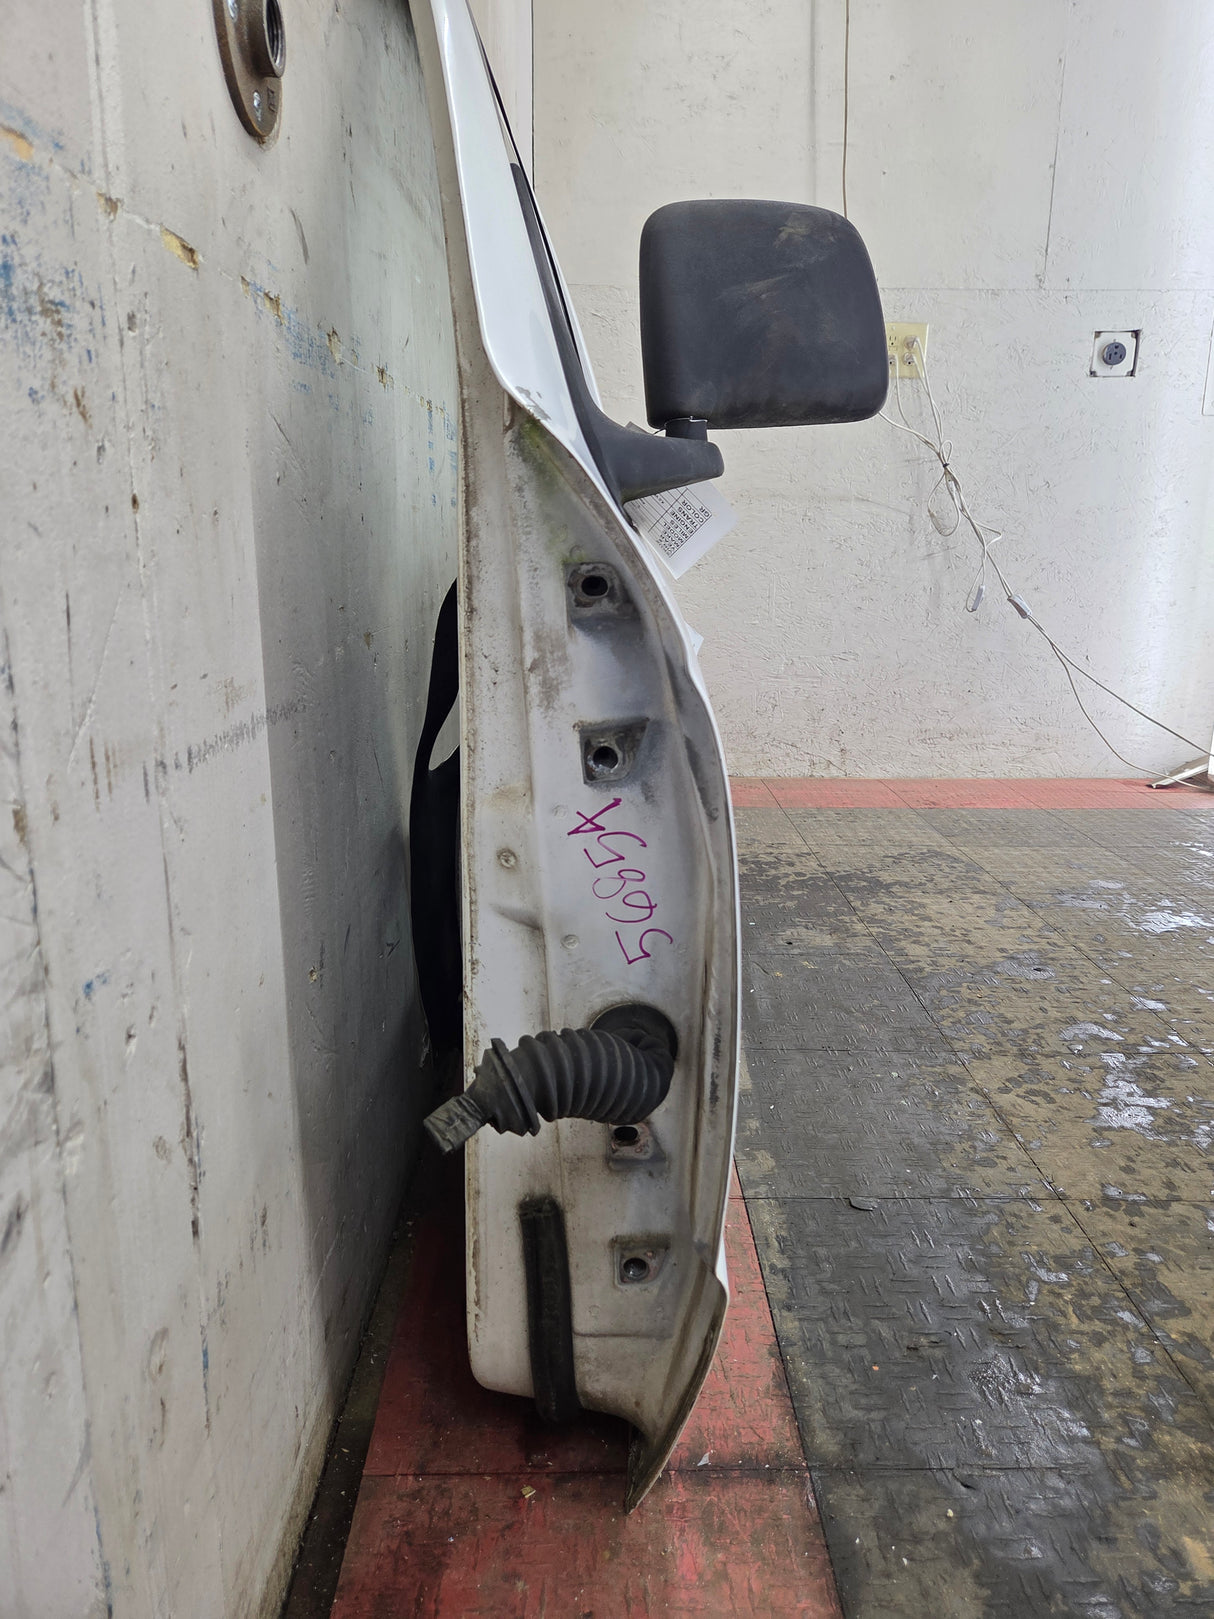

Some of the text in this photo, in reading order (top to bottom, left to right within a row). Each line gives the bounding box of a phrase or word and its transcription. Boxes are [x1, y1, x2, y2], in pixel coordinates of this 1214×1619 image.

[669, 508, 694, 534] ENGINE
[676, 505, 699, 529] TRANS
[680, 498, 704, 524] COLOR
[697, 504, 710, 518] GR
[661, 520, 684, 544] MODEL
[661, 529, 680, 548] MAKE
[668, 518, 689, 539] MILES
